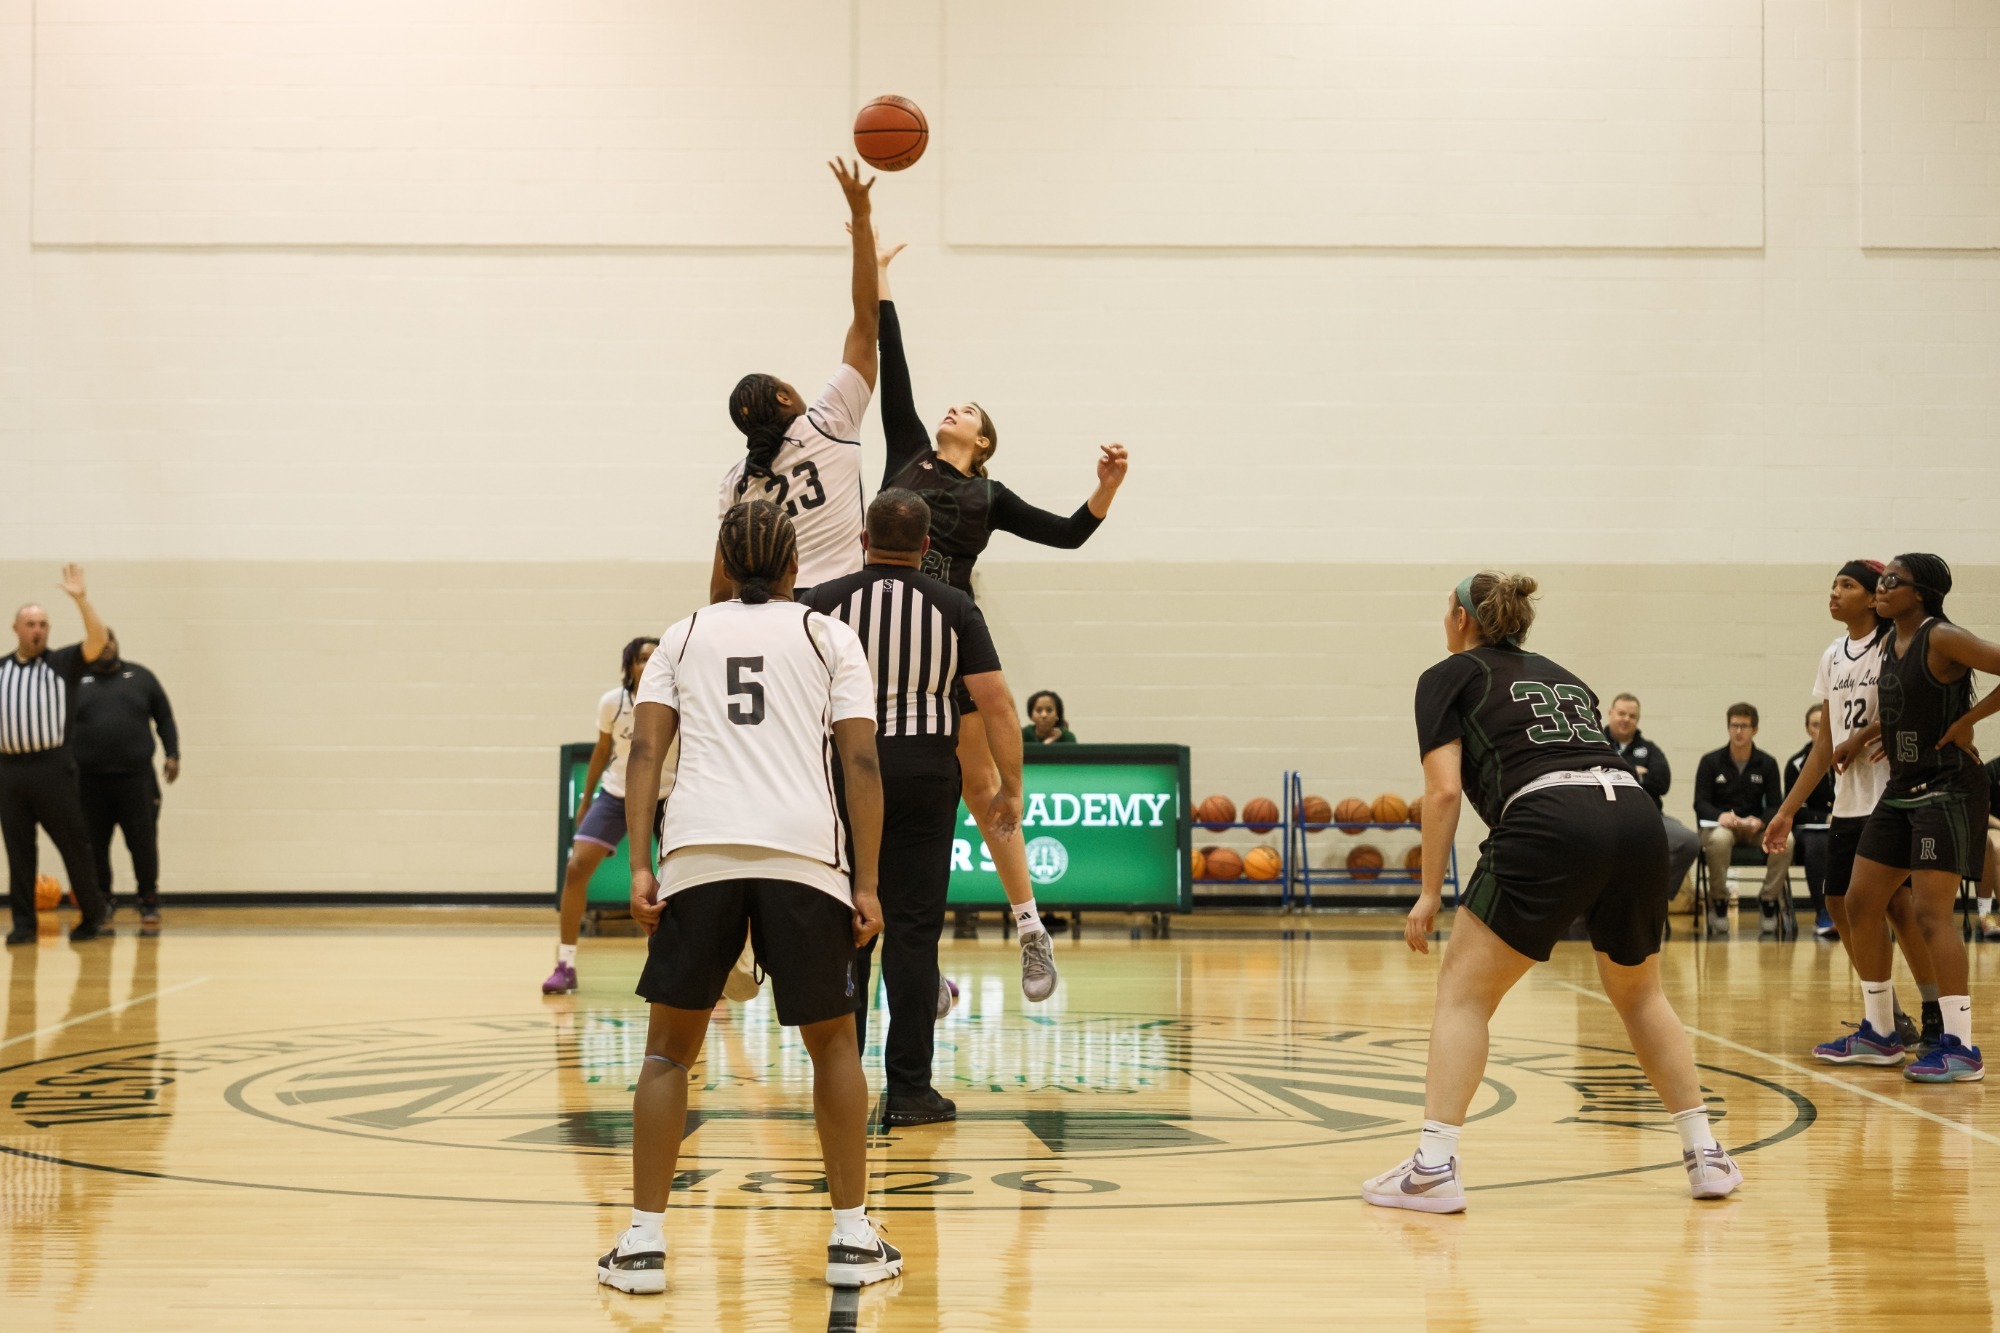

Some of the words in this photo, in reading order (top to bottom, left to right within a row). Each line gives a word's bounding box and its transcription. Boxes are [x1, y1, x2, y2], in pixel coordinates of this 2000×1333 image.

[764, 460, 826, 517] 23
[919, 549, 952, 583] 21
[727, 655, 765, 725] 5
[1832, 672, 1855, 693] Lady
[1510, 681, 1610, 745] 33
[1844, 697, 1868, 730] 22
[1896, 731, 1919, 763] 15
[964, 793, 1171, 827] ADEMY
[1920, 837, 1937, 860] R
[622, 1168, 1121, 1196] 1826
